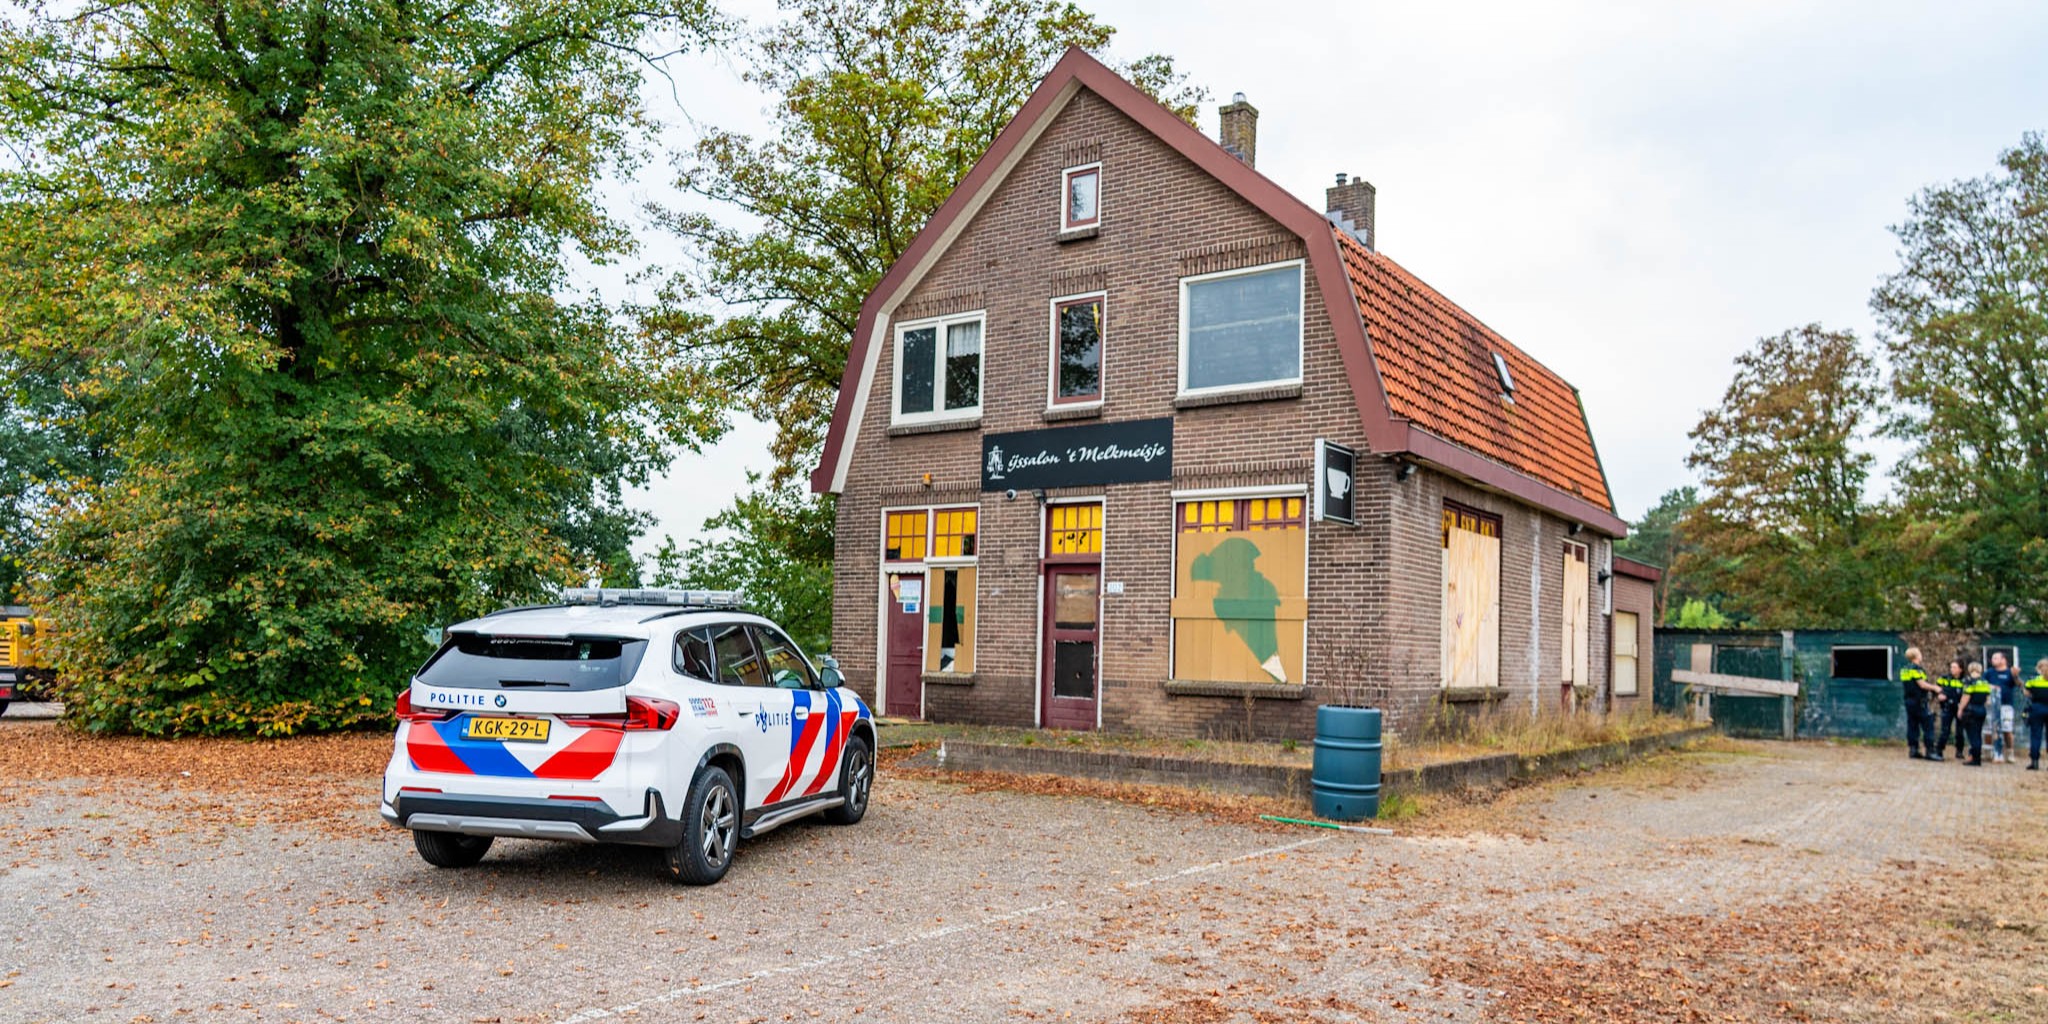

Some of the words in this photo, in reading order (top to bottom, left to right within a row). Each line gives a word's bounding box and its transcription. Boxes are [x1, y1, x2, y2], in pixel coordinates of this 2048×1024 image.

[1078, 442, 1167, 463] Melkmeisje
[430, 692, 485, 706] POLITIE
[702, 697, 716, 709] 112
[474, 720, 542, 737] KGK-29-L
